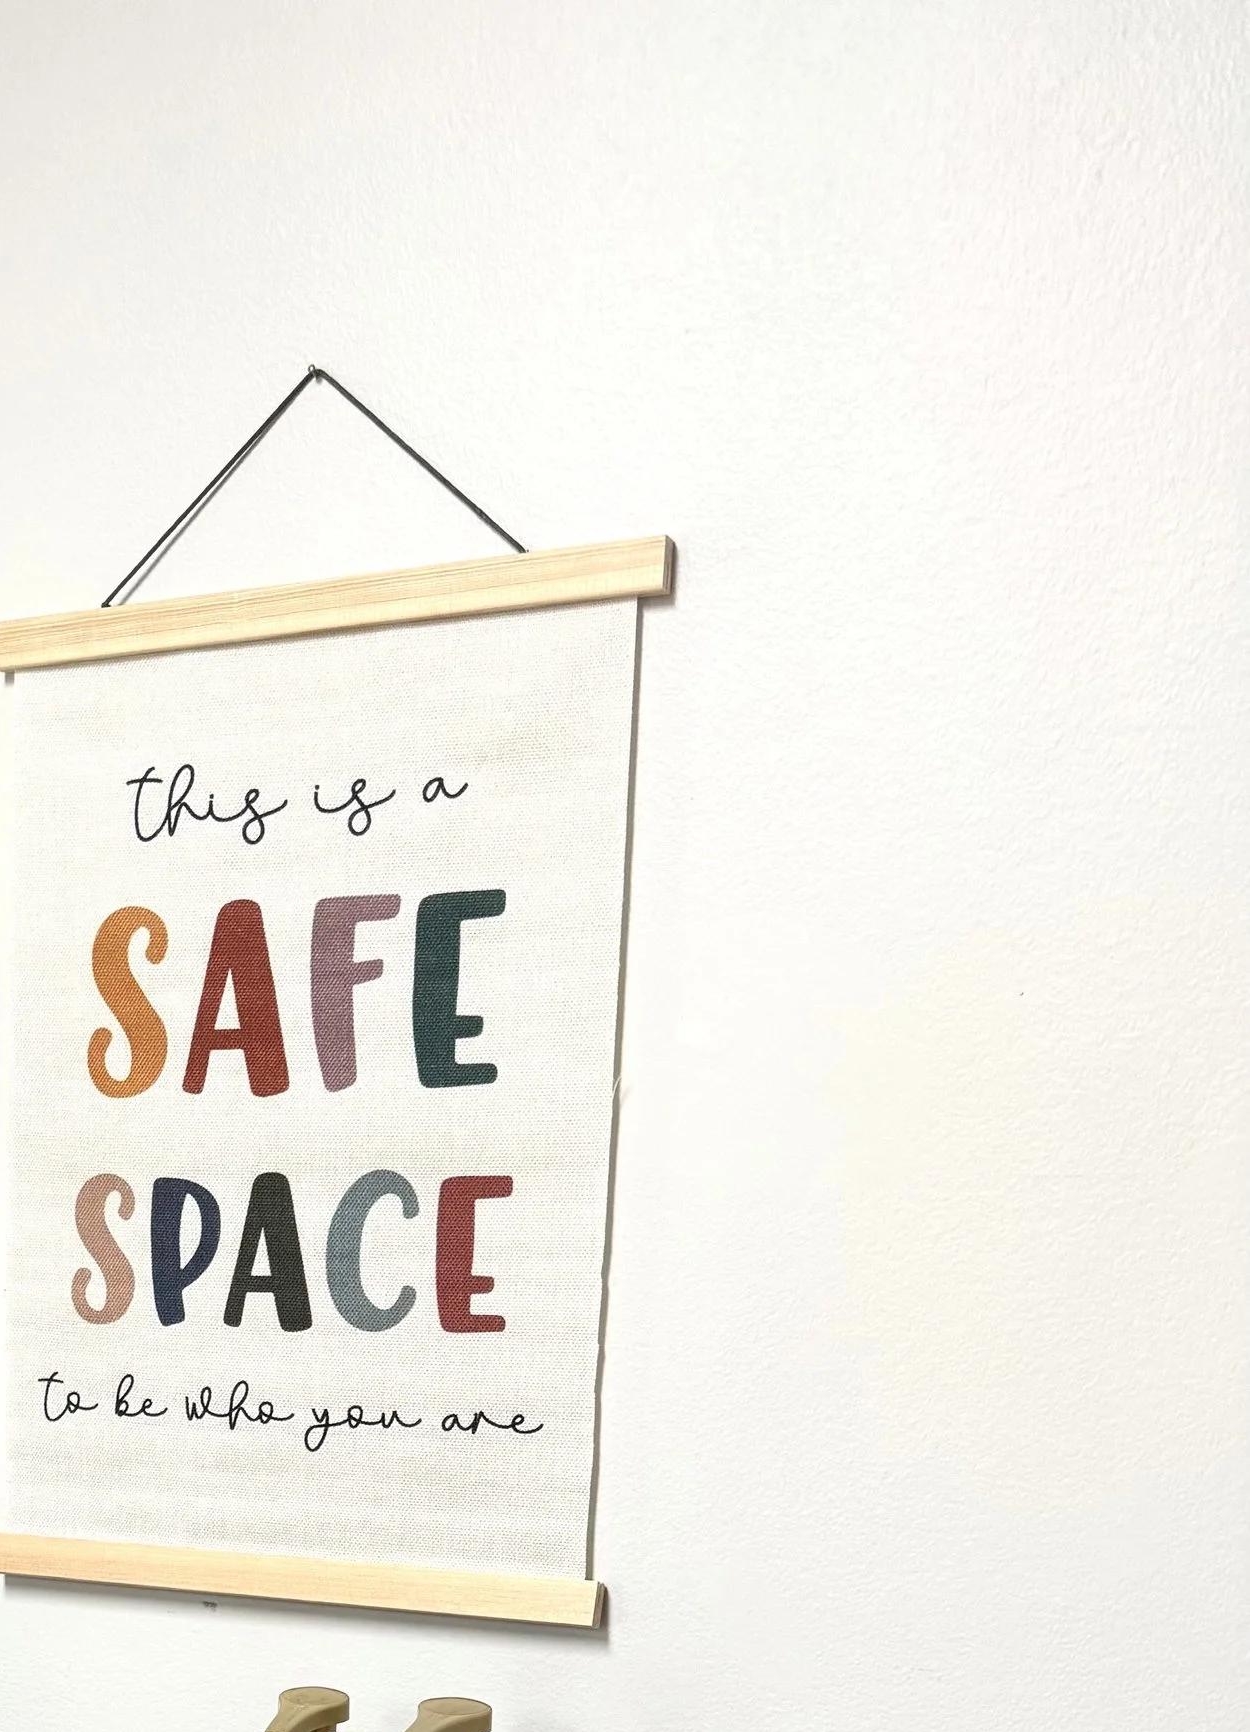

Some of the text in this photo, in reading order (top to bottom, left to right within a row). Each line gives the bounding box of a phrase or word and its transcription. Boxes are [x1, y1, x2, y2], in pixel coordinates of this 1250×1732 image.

[126, 764, 468, 844] this is a
[87, 888, 506, 1099] SAFE
[71, 1169, 514, 1333] SPACE
[39, 1371, 544, 1451] to be who you are
